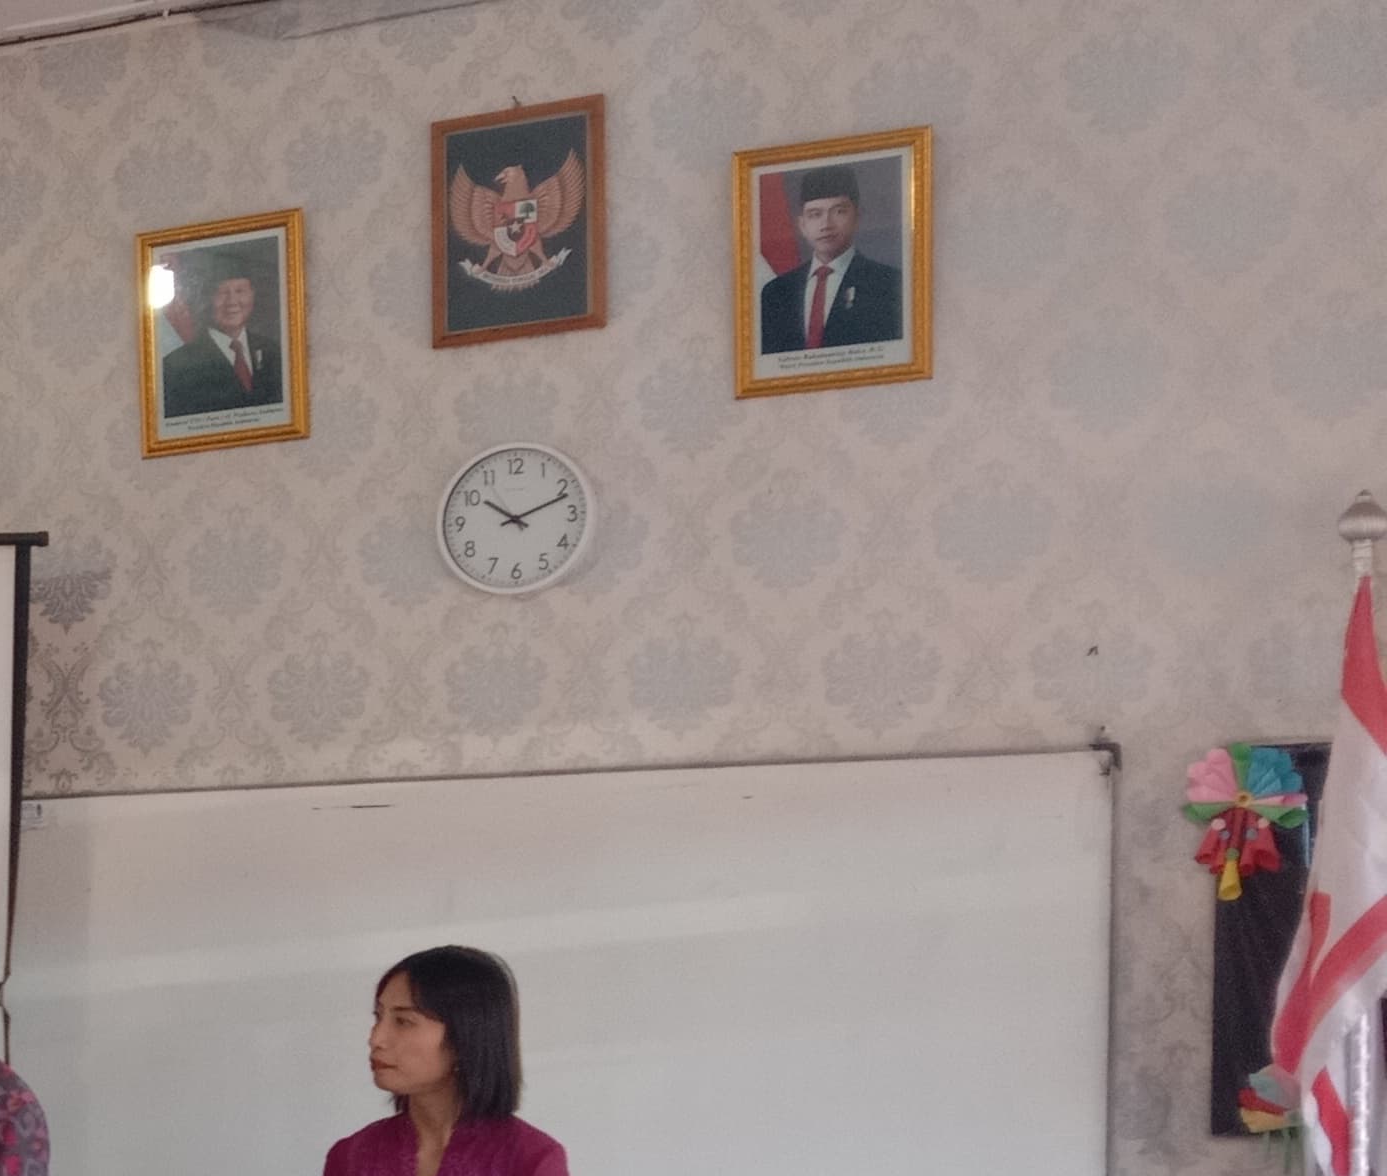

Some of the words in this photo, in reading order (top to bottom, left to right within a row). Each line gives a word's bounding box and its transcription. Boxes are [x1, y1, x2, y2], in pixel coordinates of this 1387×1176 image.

[507, 458, 524, 475] 12
[483, 470, 495, 486] 11
[556, 478, 568, 497] 2
[464, 490, 481, 506] 10
[567, 504, 578, 522] 3
[455, 516, 466, 532] 9
[464, 540, 476, 558] 8
[556, 533, 569, 550] 4
[488, 557, 499, 575] 7
[539, 553, 549, 570] 5
[511, 562, 522, 580] 6
